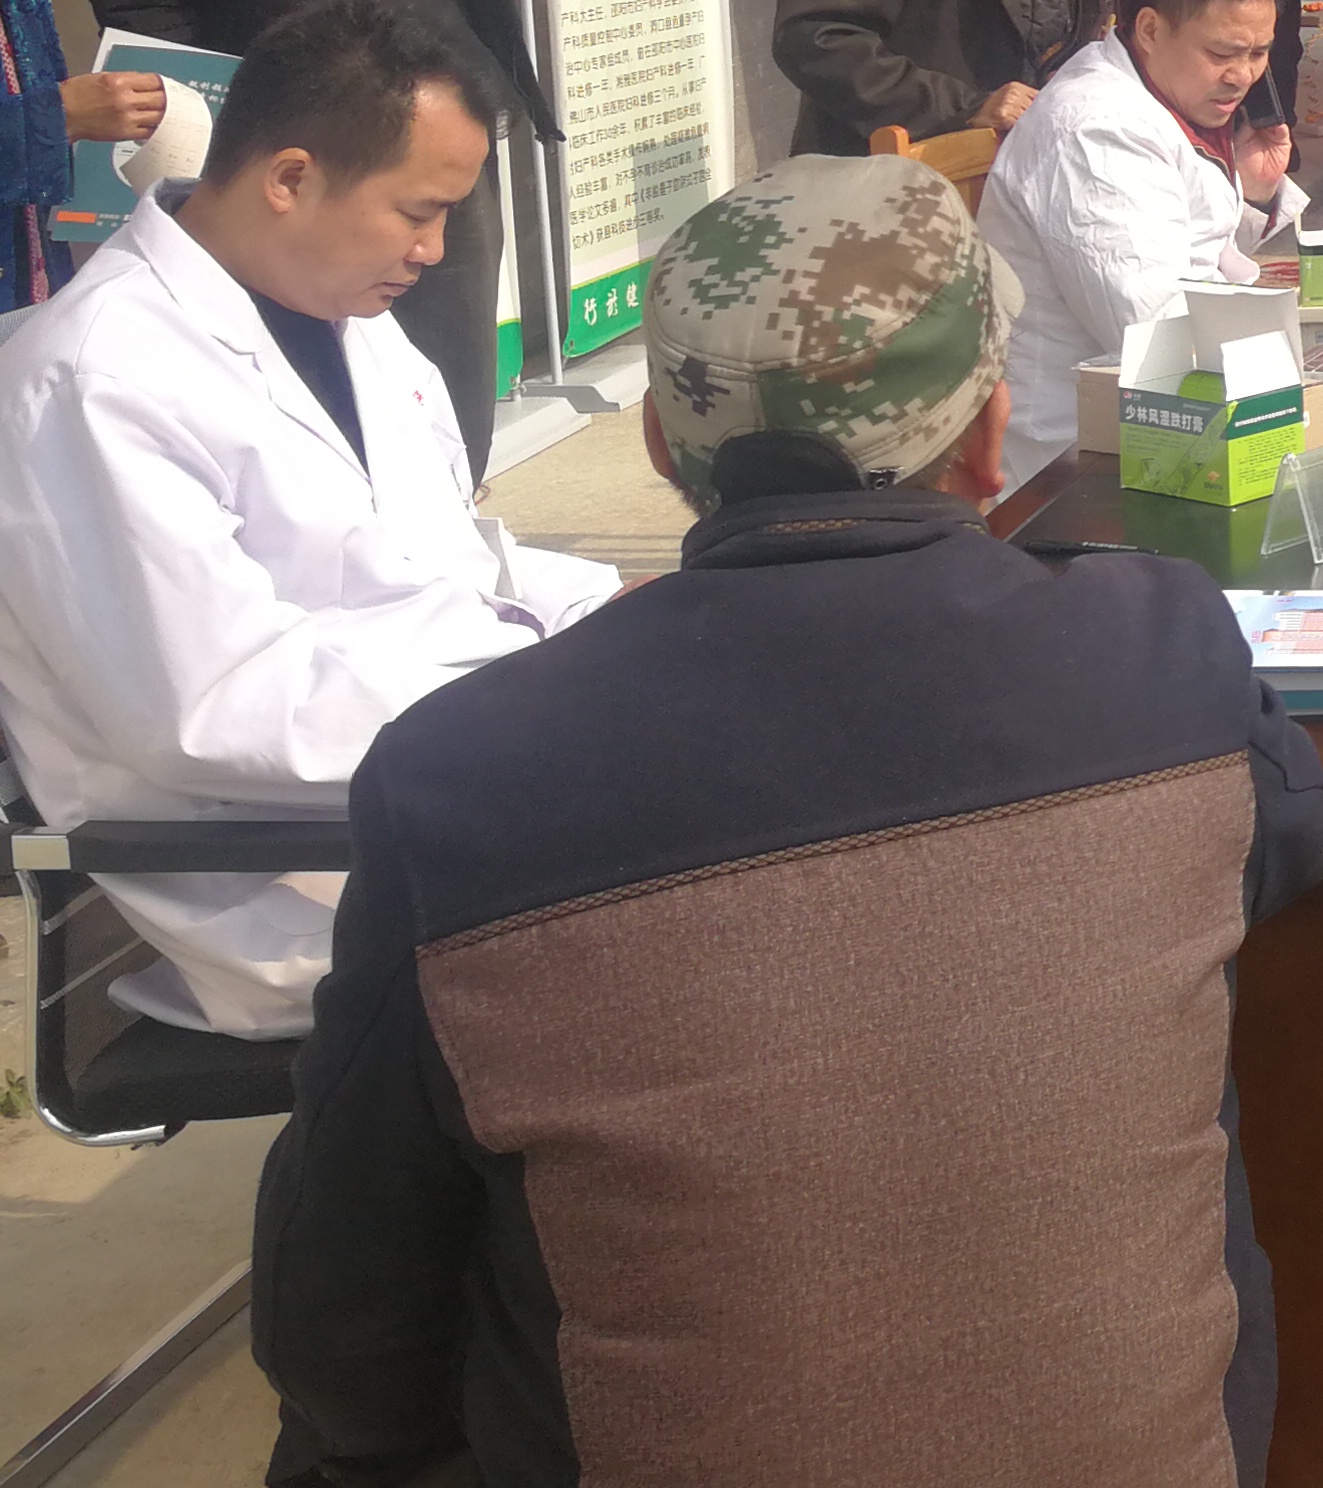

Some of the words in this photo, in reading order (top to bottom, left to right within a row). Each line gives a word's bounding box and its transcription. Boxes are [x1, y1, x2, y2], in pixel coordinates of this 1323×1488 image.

[1124, 404, 1204, 434] 少林风湿跌打膏
